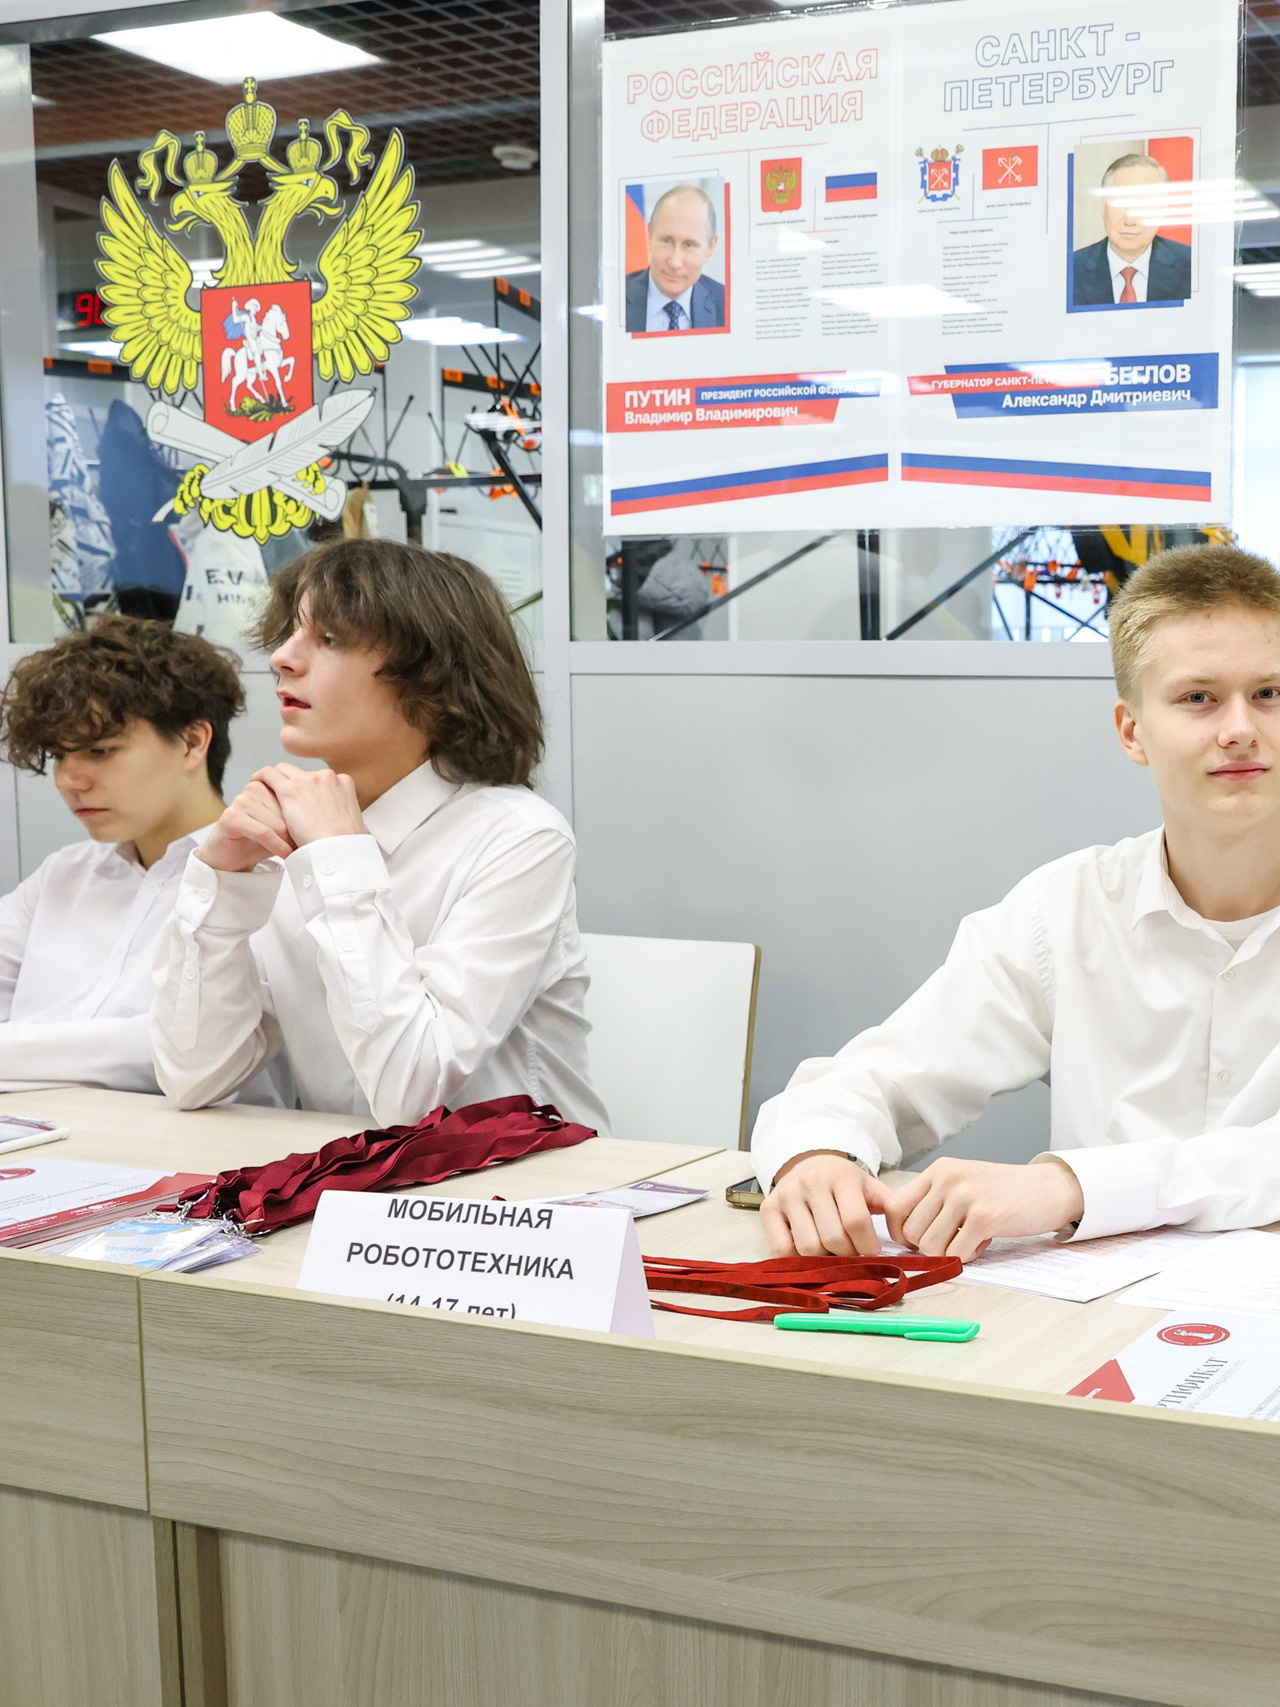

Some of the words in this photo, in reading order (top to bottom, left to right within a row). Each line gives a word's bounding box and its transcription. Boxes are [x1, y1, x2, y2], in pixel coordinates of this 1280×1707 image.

[975, 23, 1114, 68] САНКТ
[627, 48, 878, 104] РОССИЙСКАЯ
[944, 59, 1174, 112] ПЕТЕРБУРГ
[640, 90, 863, 142] ФЕДЕРАЦИЯ
[931, 377, 993, 389] ГУБЕРНАТОР
[1105, 363, 1192, 386] БЕГЛОВ
[624, 388, 690, 408] ПУТИН
[700, 389, 752, 401] ПРЕЗИДЕНТ
[754, 385, 817, 398] РОССИЙСКОЙ
[818, 383, 876, 395] ФЕДЕРАЦИИ
[1002, 391, 1087, 408] Александр
[1090, 388, 1192, 408] Дмитриевич
[624, 408, 692, 425] Владимир
[695, 405, 799, 422] Владимирович
[387, 1198, 553, 1230] МОБИЛЬНАЯ
[346, 1242, 575, 1280] РОБОТОТЕХНИКА
[1154, 1356, 1228, 1408] ТИФИКАТ
